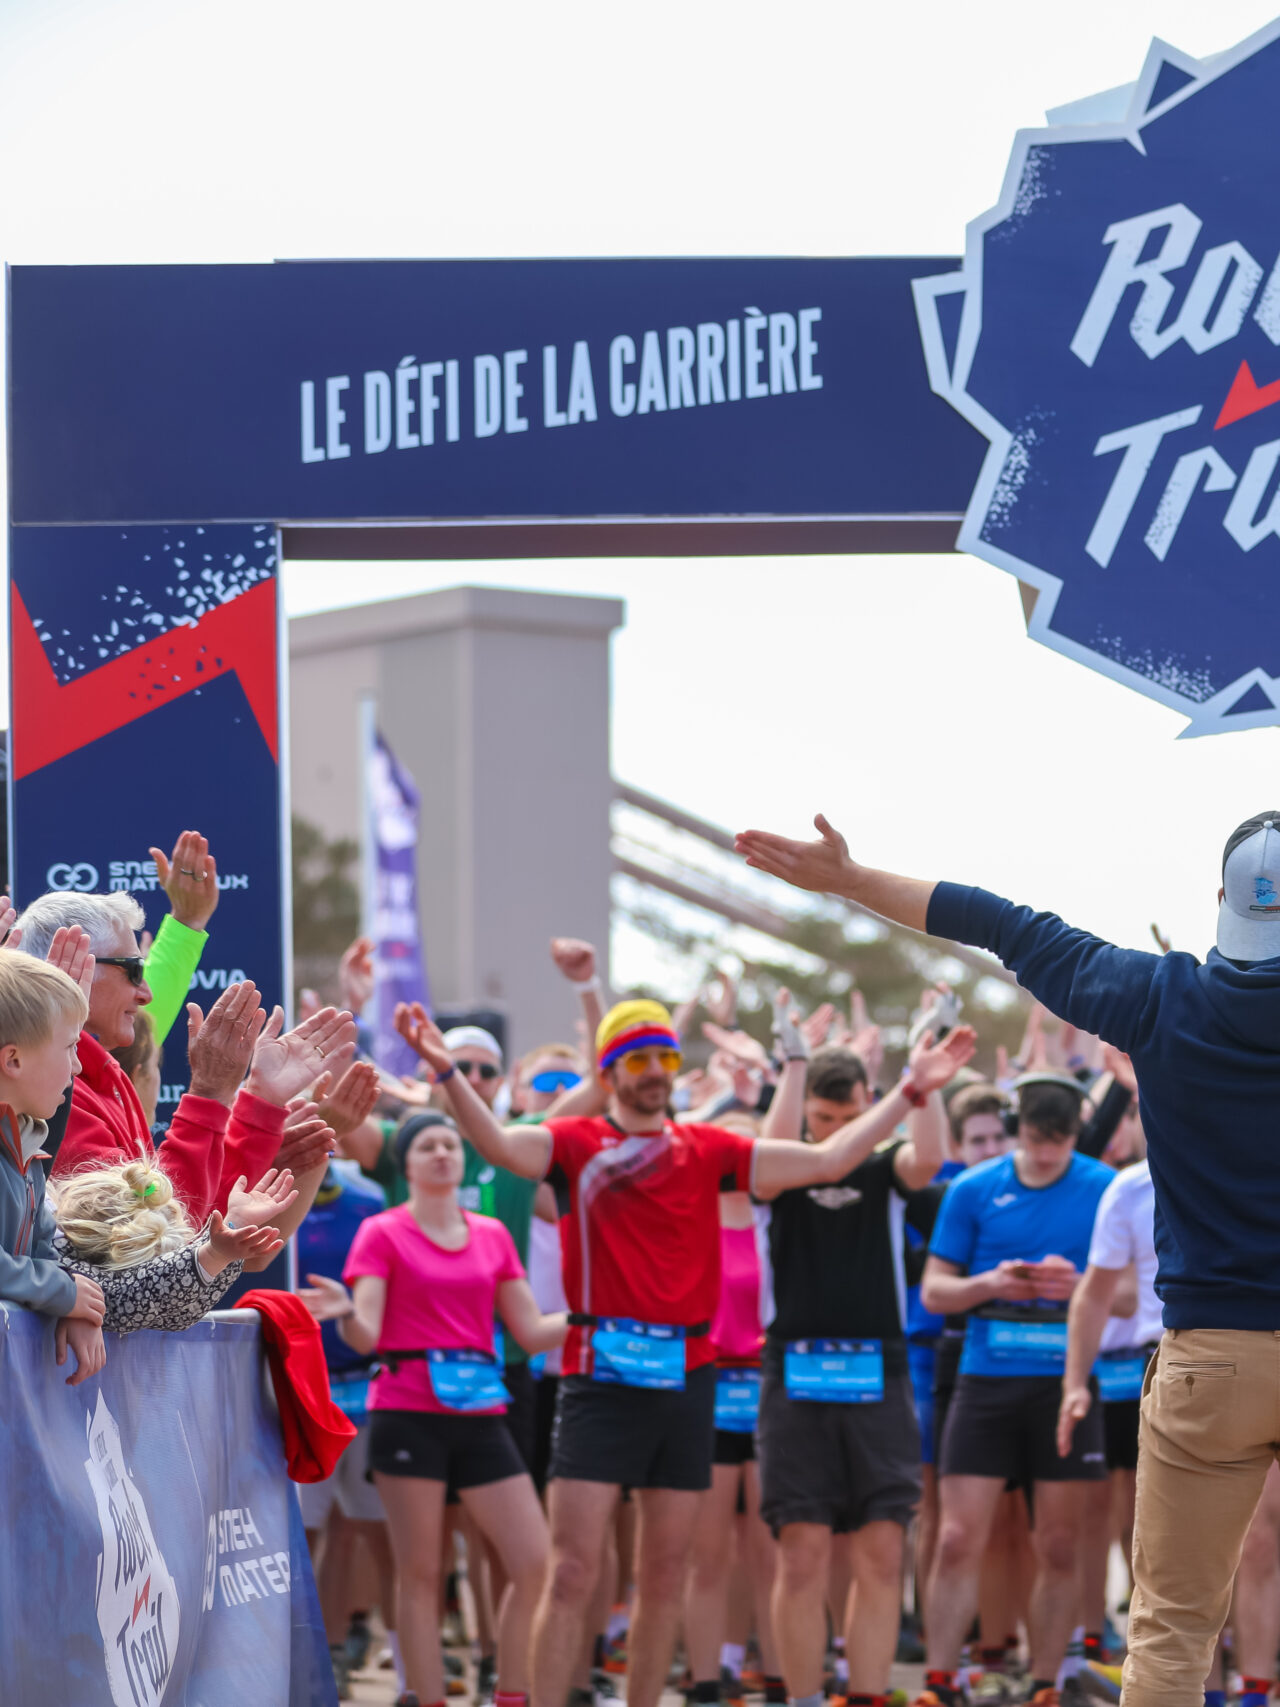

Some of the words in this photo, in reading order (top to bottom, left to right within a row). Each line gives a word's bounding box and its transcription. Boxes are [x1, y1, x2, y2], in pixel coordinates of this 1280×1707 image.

[301, 376, 350, 463] LE
[365, 356, 459, 453] DÉFI
[475, 350, 528, 437] DE
[544, 341, 597, 427] LA
[610, 307, 822, 416] CARRIÈRE
[109, 861, 164, 876] SNE
[109, 875, 249, 892] MATUX
[108, 1479, 152, 1593] Rock
[219, 1552, 291, 1607] MATER
[117, 1592, 172, 1707] Trail
